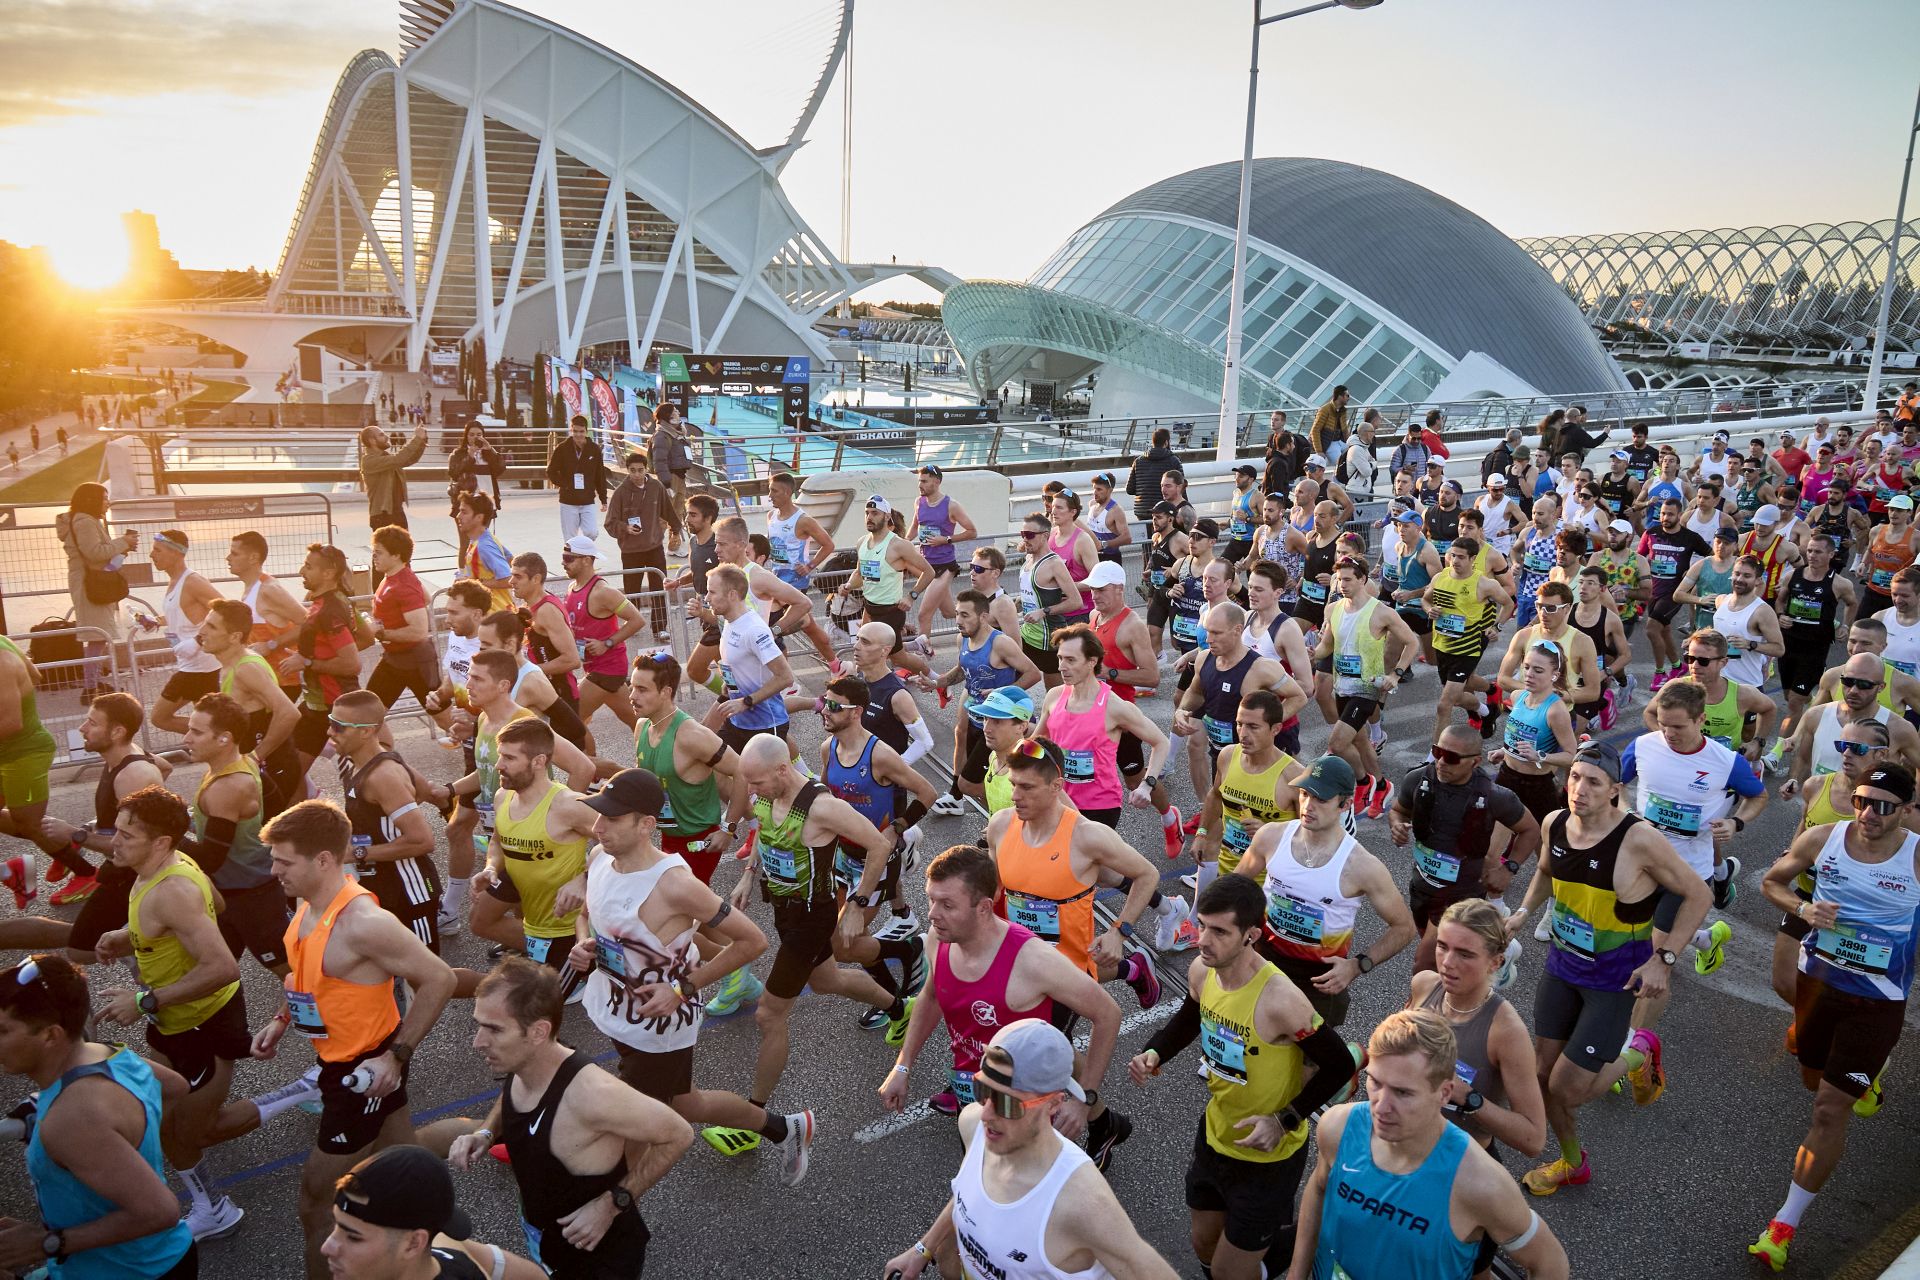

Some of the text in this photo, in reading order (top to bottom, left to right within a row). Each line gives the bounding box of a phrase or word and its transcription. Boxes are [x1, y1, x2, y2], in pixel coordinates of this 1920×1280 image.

[1223, 785, 1274, 808] CORRECAMINOS
[1658, 807, 1683, 819] 33391
[1658, 816, 1682, 828] Halvor
[1423, 856, 1441, 869] 3303
[1016, 910, 1037, 922] 3698
[1277, 908, 1305, 925] 33292
[1839, 938, 1867, 953] 3898
[1835, 947, 1867, 964] DANIEL
[1208, 1035, 1225, 1052] 4680
[1337, 1181, 1430, 1235] SPARTA
